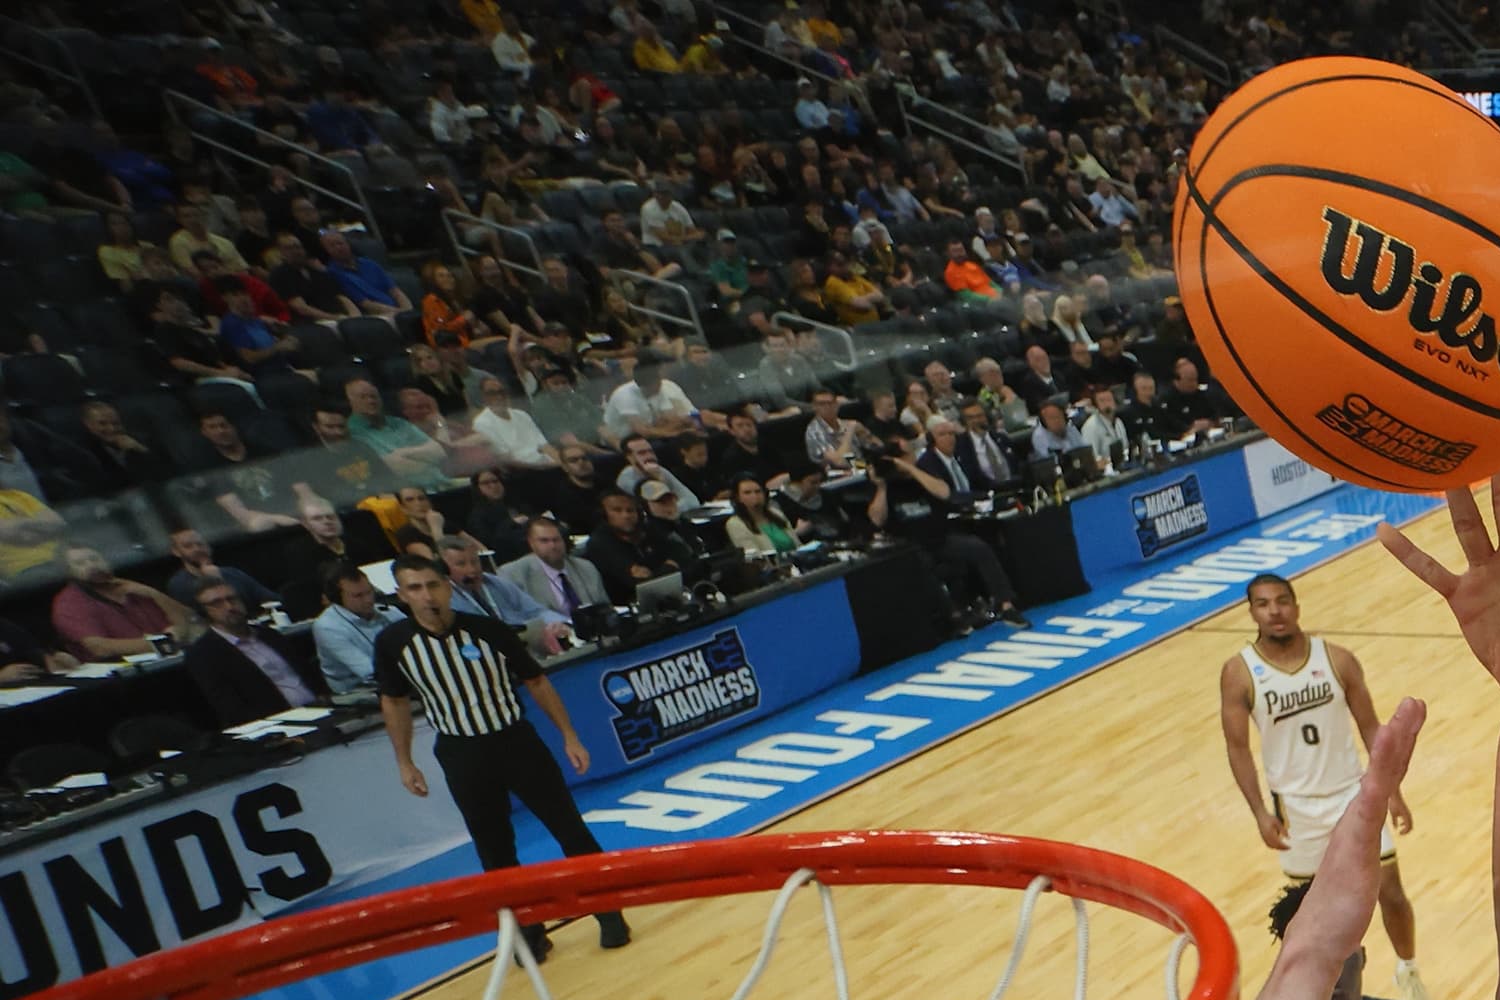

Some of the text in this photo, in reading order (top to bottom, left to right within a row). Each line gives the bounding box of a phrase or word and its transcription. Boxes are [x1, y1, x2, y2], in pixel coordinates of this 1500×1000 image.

[1413, 339, 1489, 382] EVO NXT
[1362, 429, 1453, 473] MADNESS
[1365, 408, 1440, 451] MARCH
[1144, 485, 1186, 517] MARCH
[1155, 502, 1208, 540] MADNESS
[1122, 537, 1324, 601] ROAD
[629, 650, 711, 701] MARCH
[866, 615, 1147, 701] FINAL
[654, 667, 756, 728] MADNESS
[1264, 681, 1334, 722] Purdue
[1301, 723, 1320, 746] 0
[583, 710, 931, 833] FOUR
